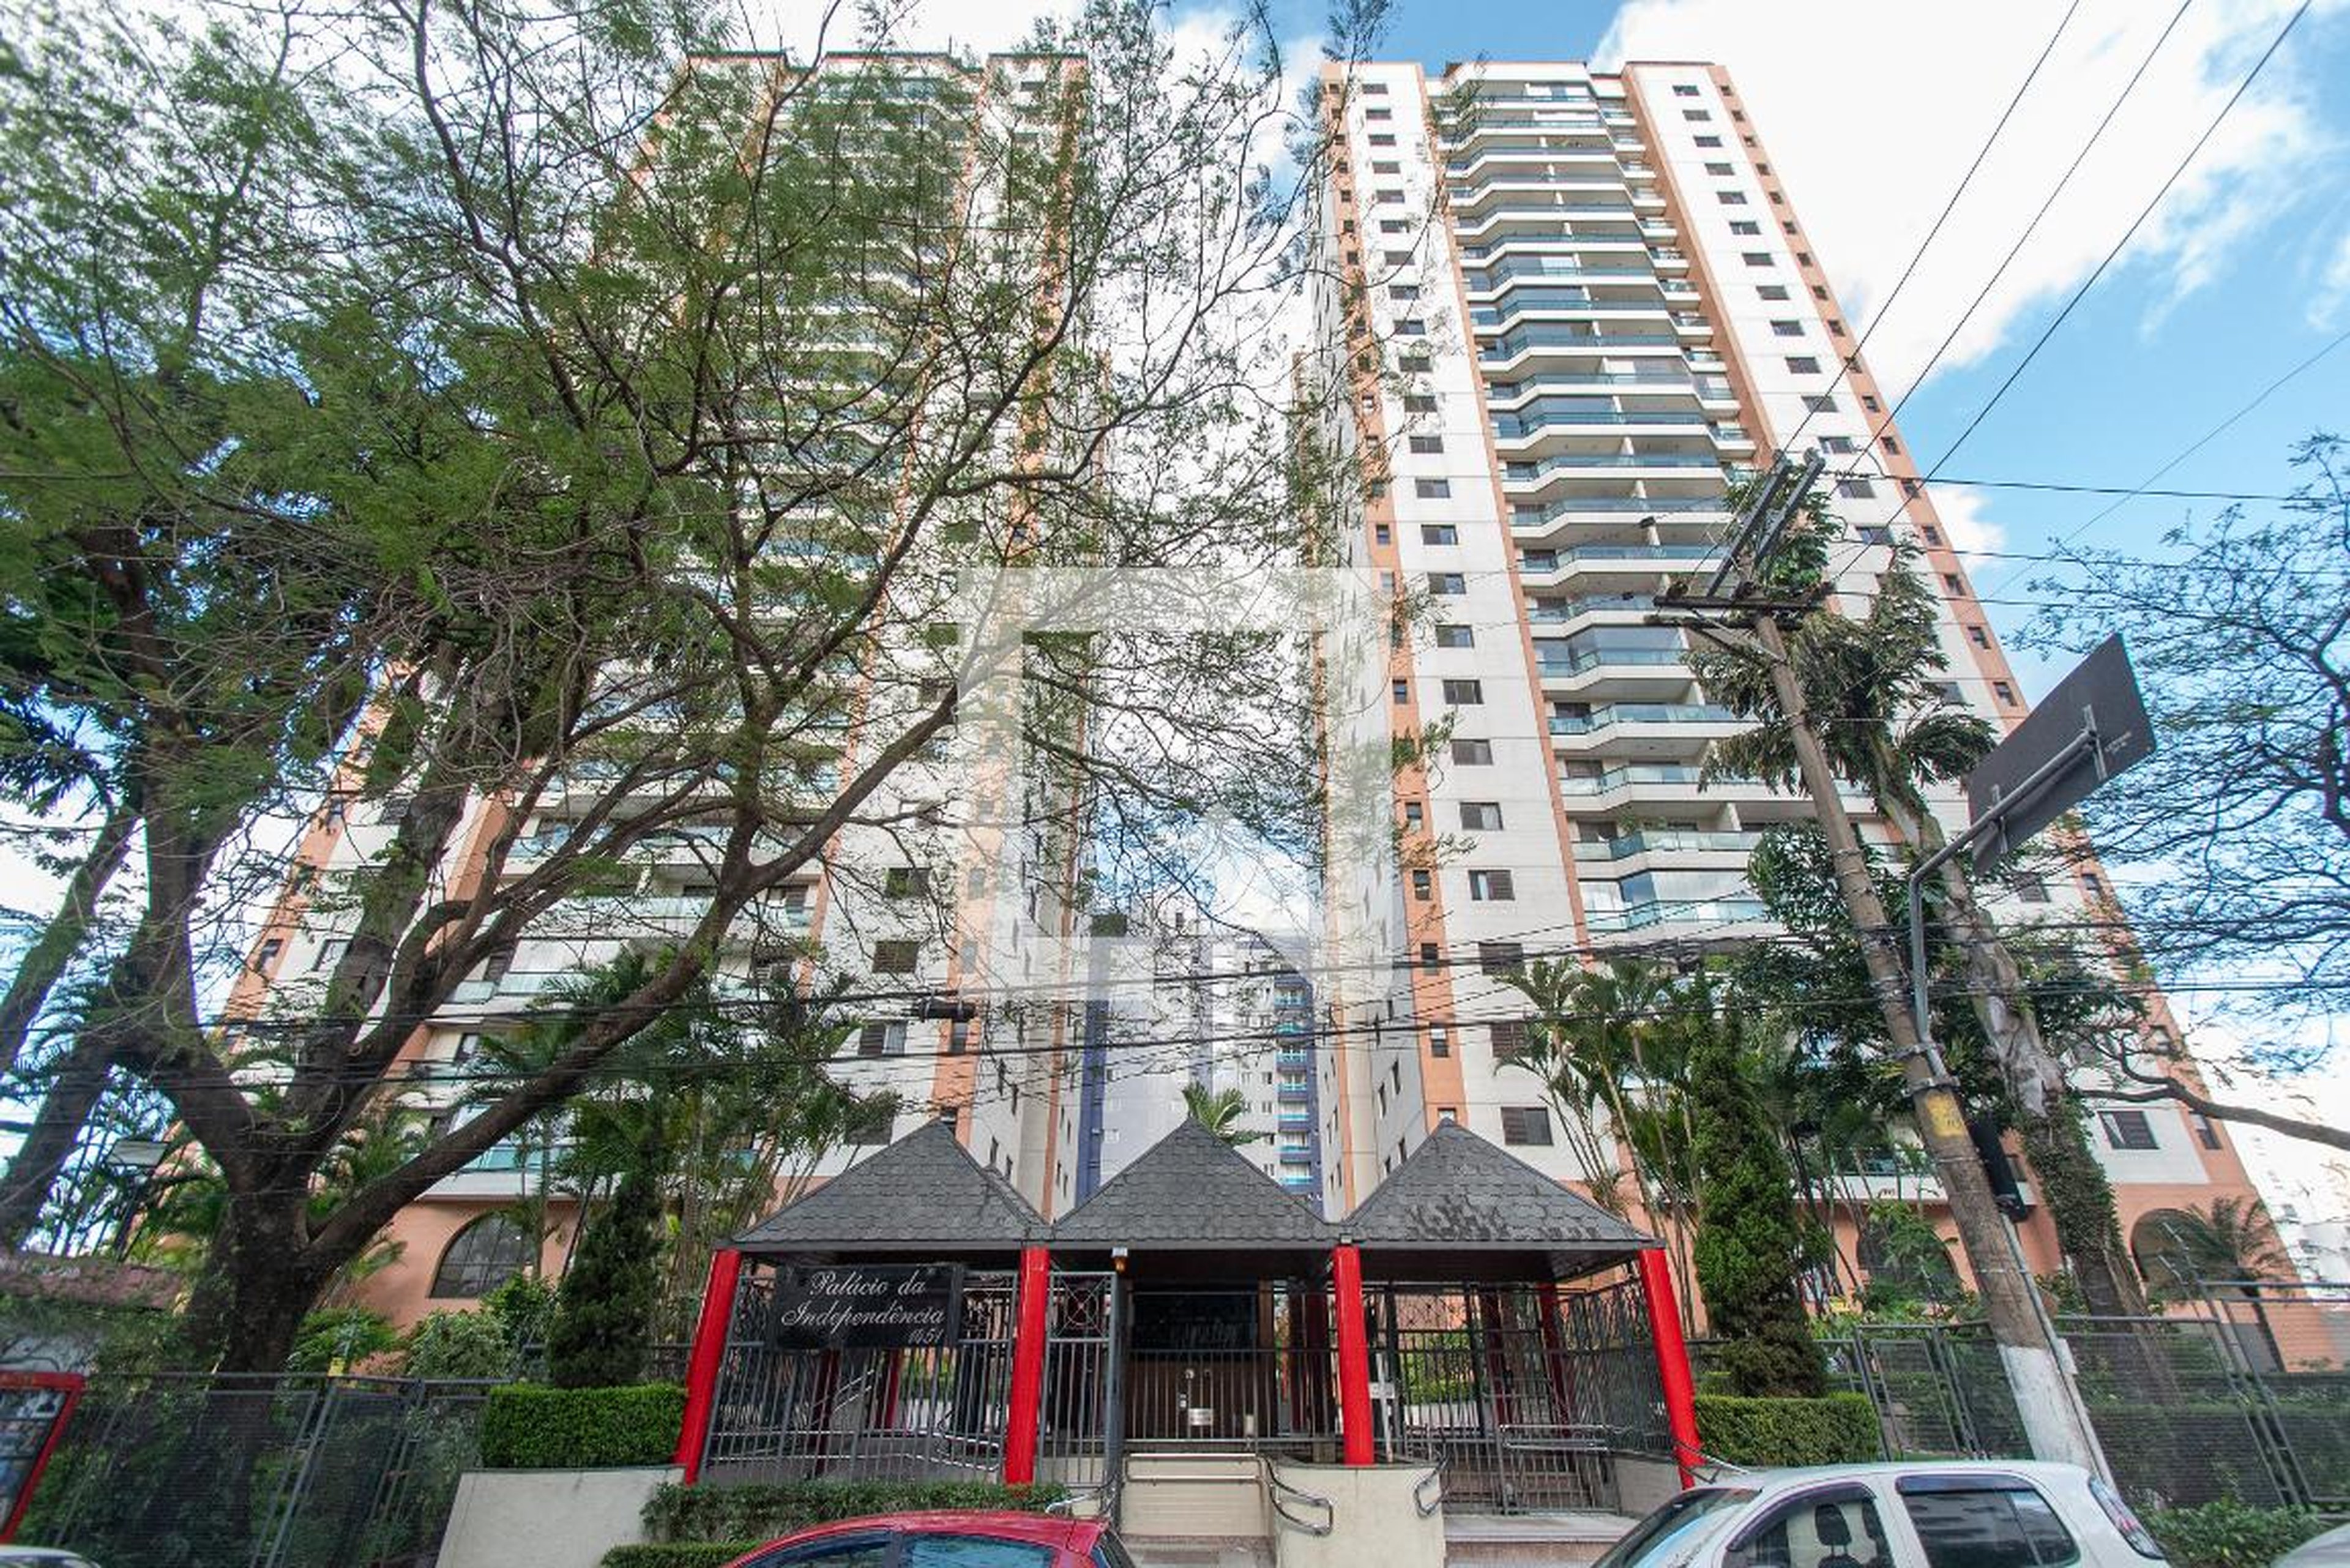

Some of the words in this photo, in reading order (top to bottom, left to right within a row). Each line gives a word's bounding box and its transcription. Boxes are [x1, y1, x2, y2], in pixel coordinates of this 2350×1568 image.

[809, 1271, 888, 1296] Palácio
[897, 1269, 927, 1296] da
[781, 1299, 945, 1335] Independência
